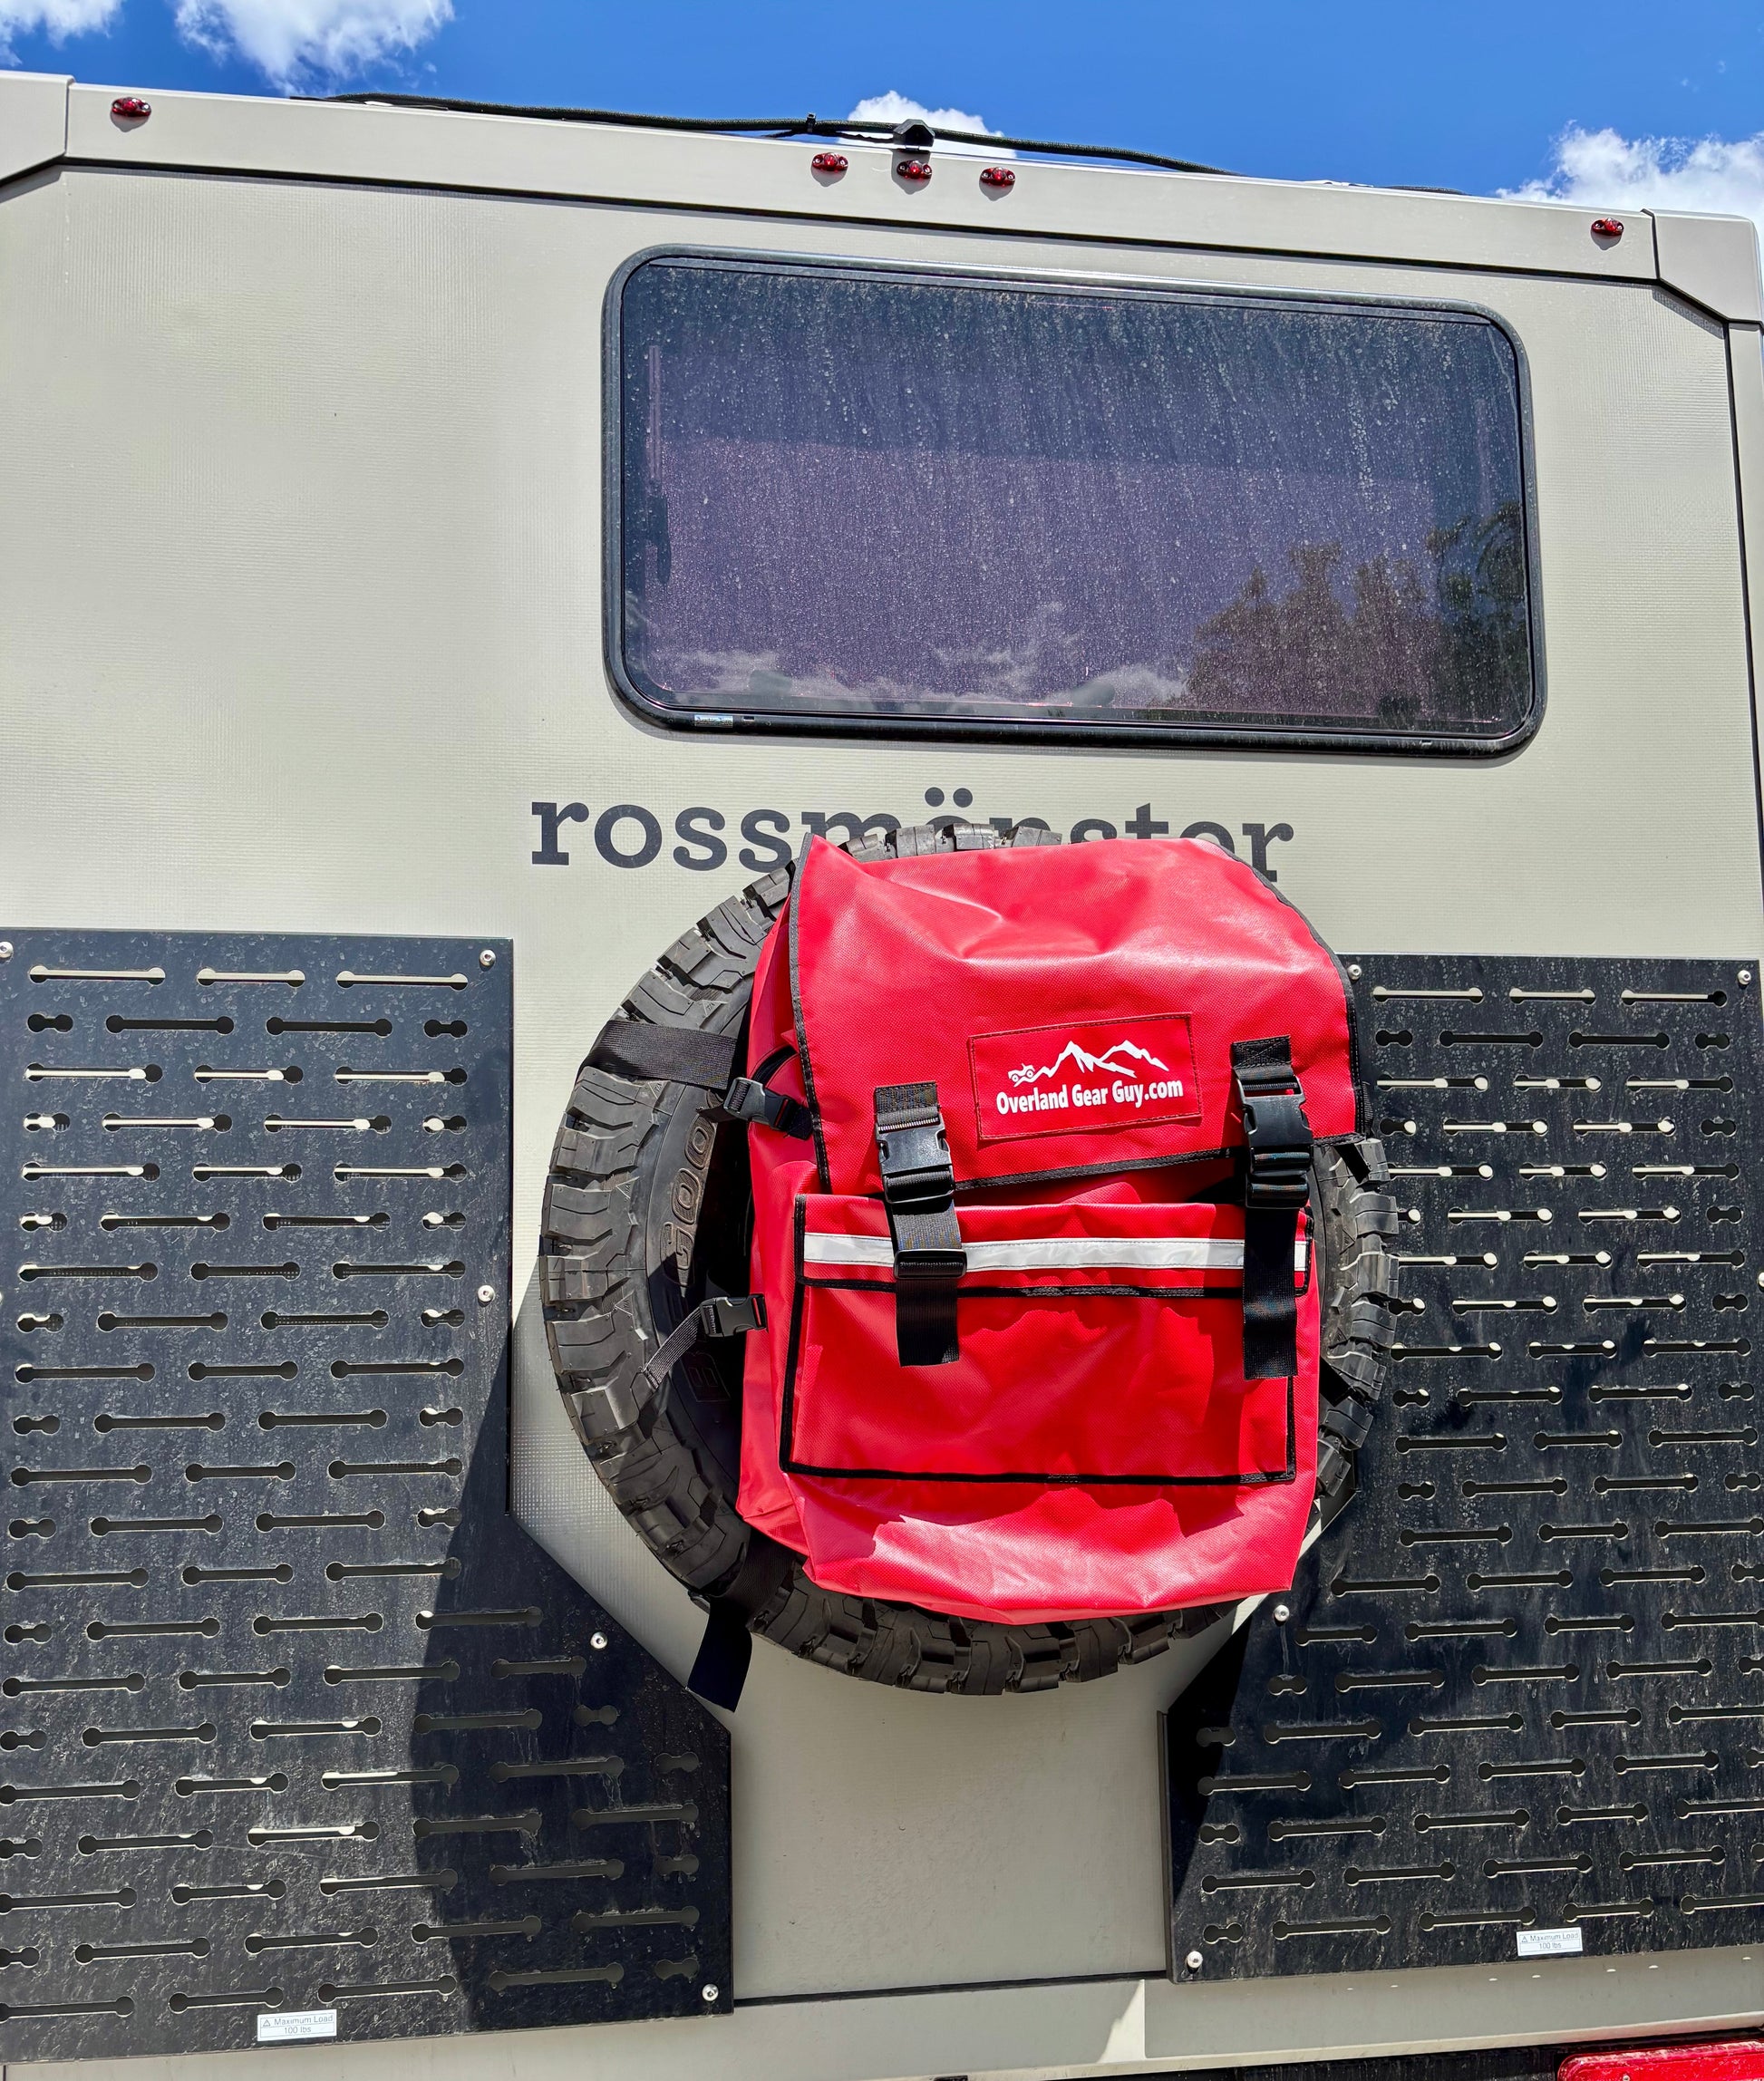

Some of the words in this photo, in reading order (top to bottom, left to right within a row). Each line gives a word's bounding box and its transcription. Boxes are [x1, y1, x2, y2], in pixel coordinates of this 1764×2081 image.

[996, 1084, 1070, 1115] Overland
[1071, 1084, 1109, 1108] Gear
[1111, 1079, 1184, 1108] Guy.com
[274, 2017, 312, 2026] Maximum
[314, 2014, 334, 2023] Load
